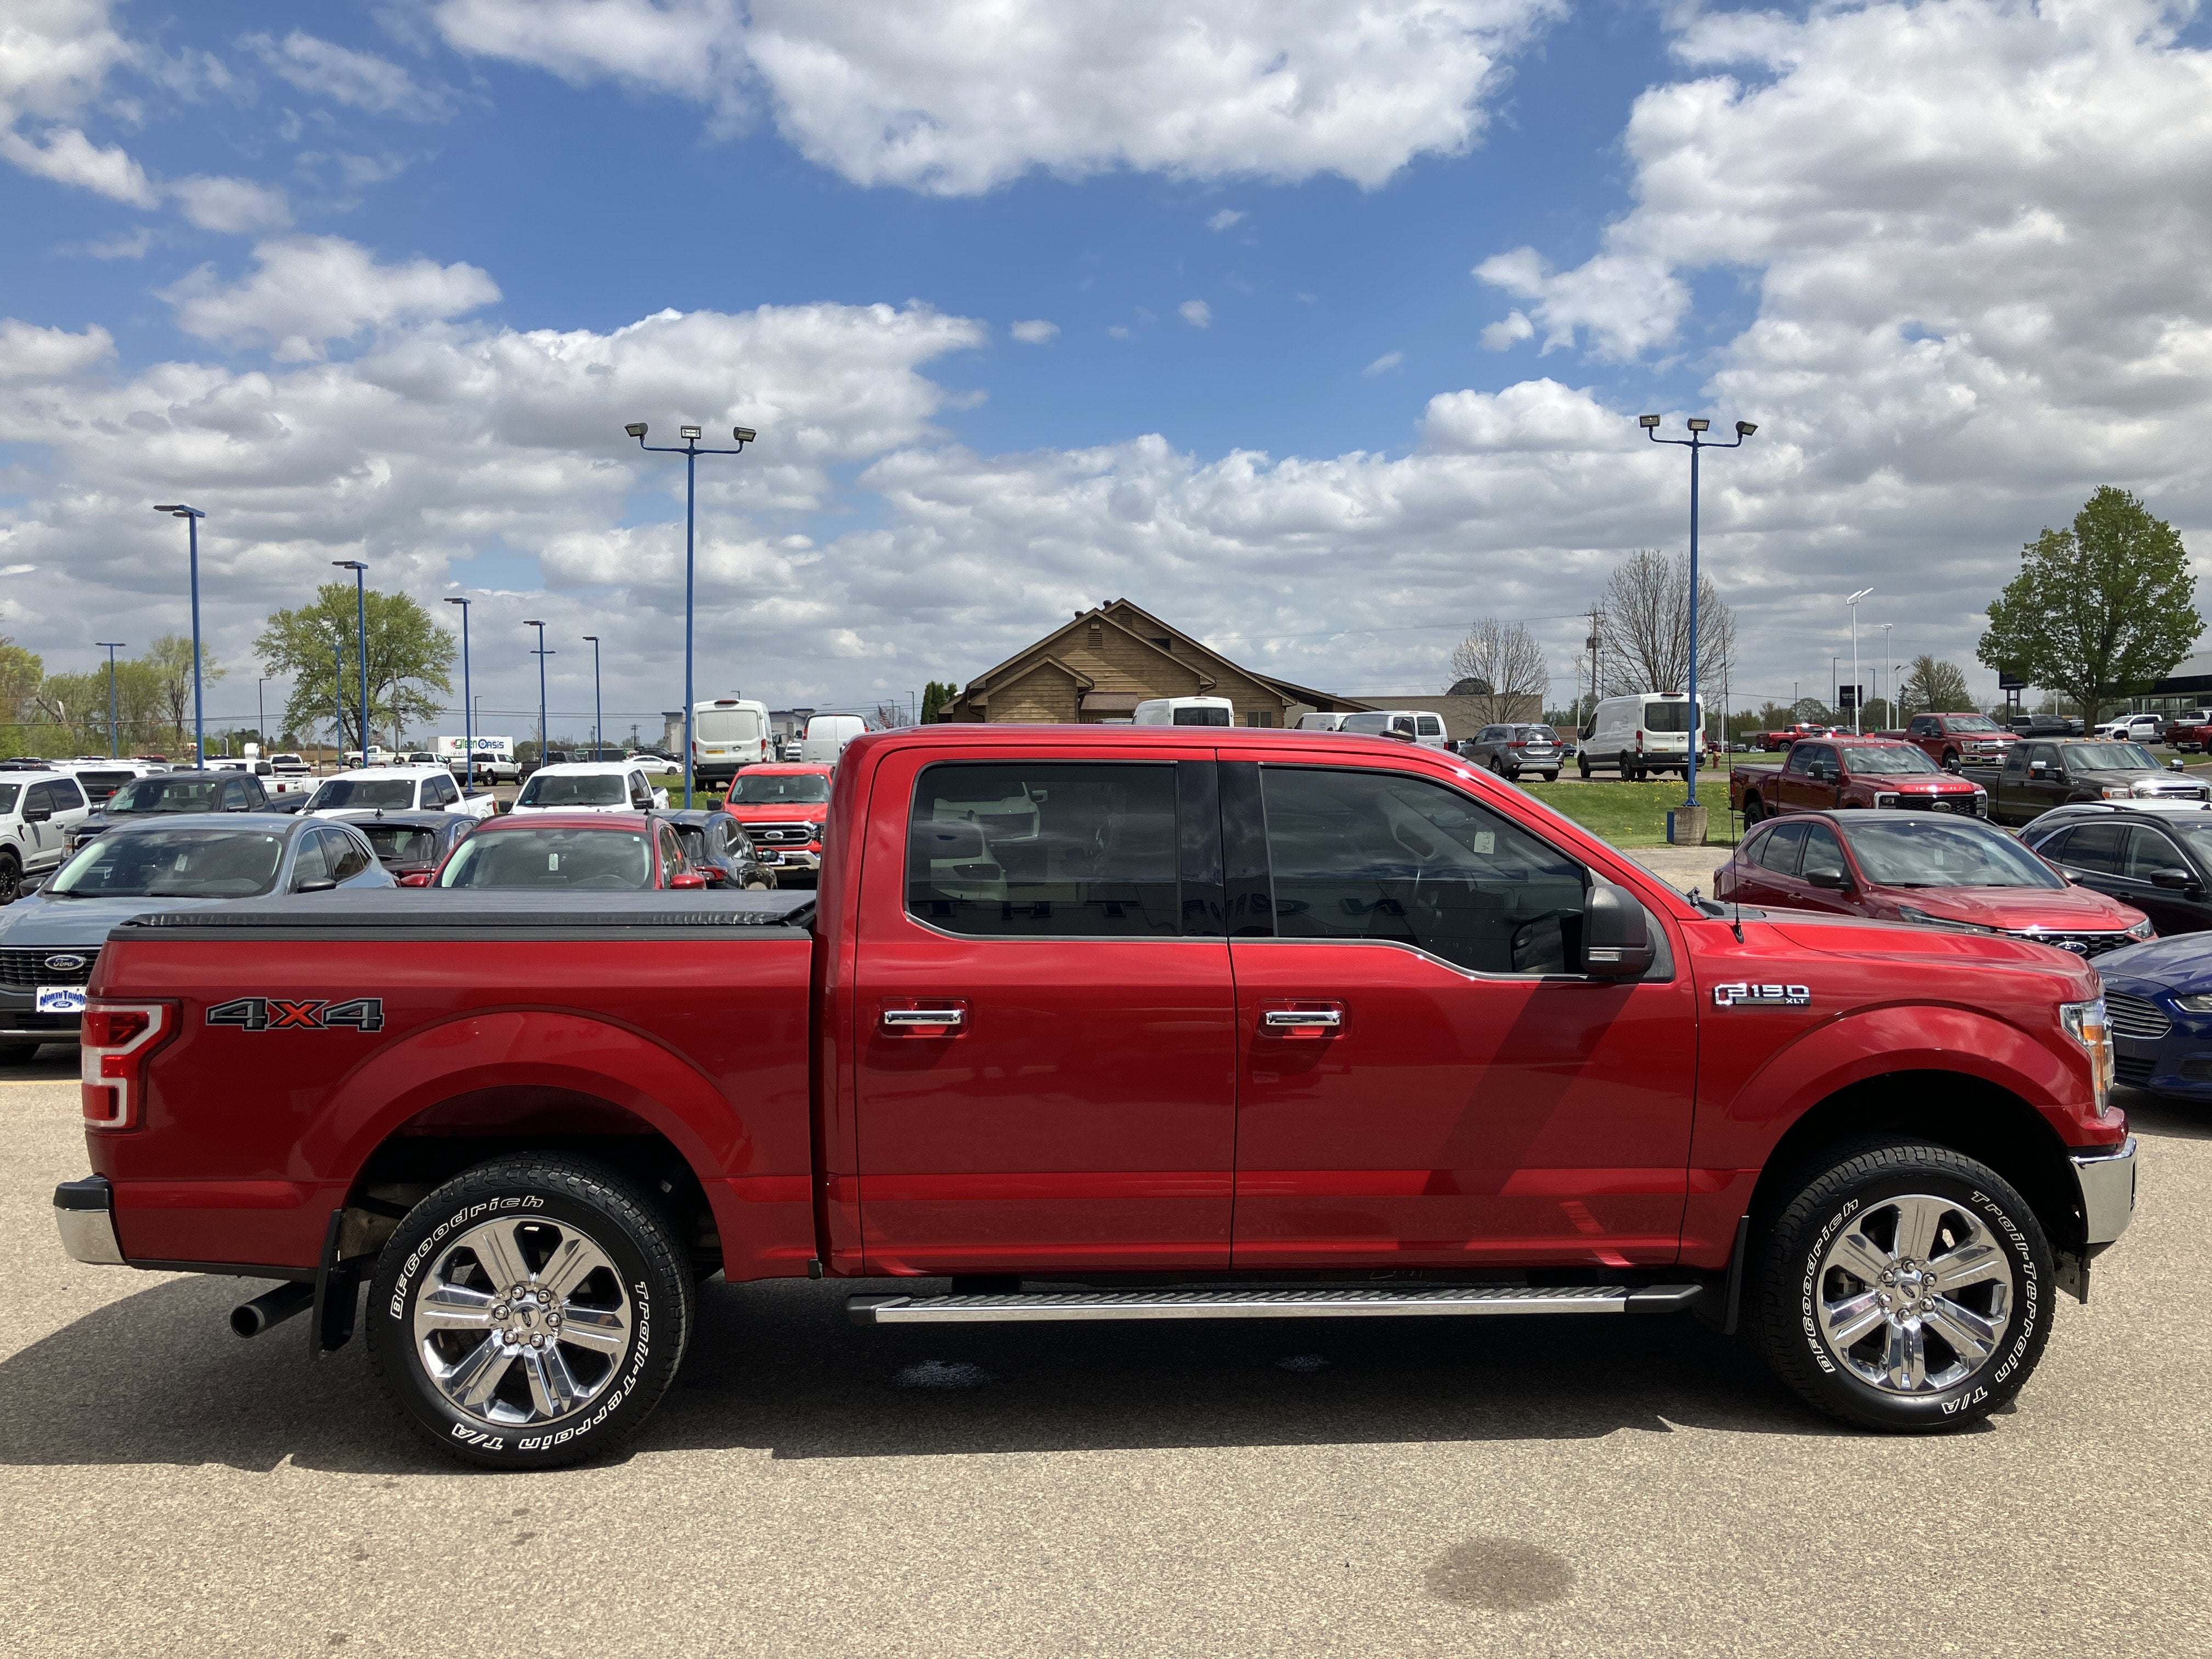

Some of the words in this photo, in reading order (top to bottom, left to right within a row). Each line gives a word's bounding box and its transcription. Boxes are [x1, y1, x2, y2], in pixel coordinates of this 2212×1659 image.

[54, 958, 75, 967] Ford
[390, 1195, 544, 1320] BFGoodrich
[1802, 1197, 1859, 1373] BFGoodrich
[1971, 1190, 2039, 1383] Trail-Terrain
[517, 1282, 650, 1450] Trail-Terrain
[1941, 1385, 1988, 1414] T/A
[452, 1422, 504, 1451] T/A
